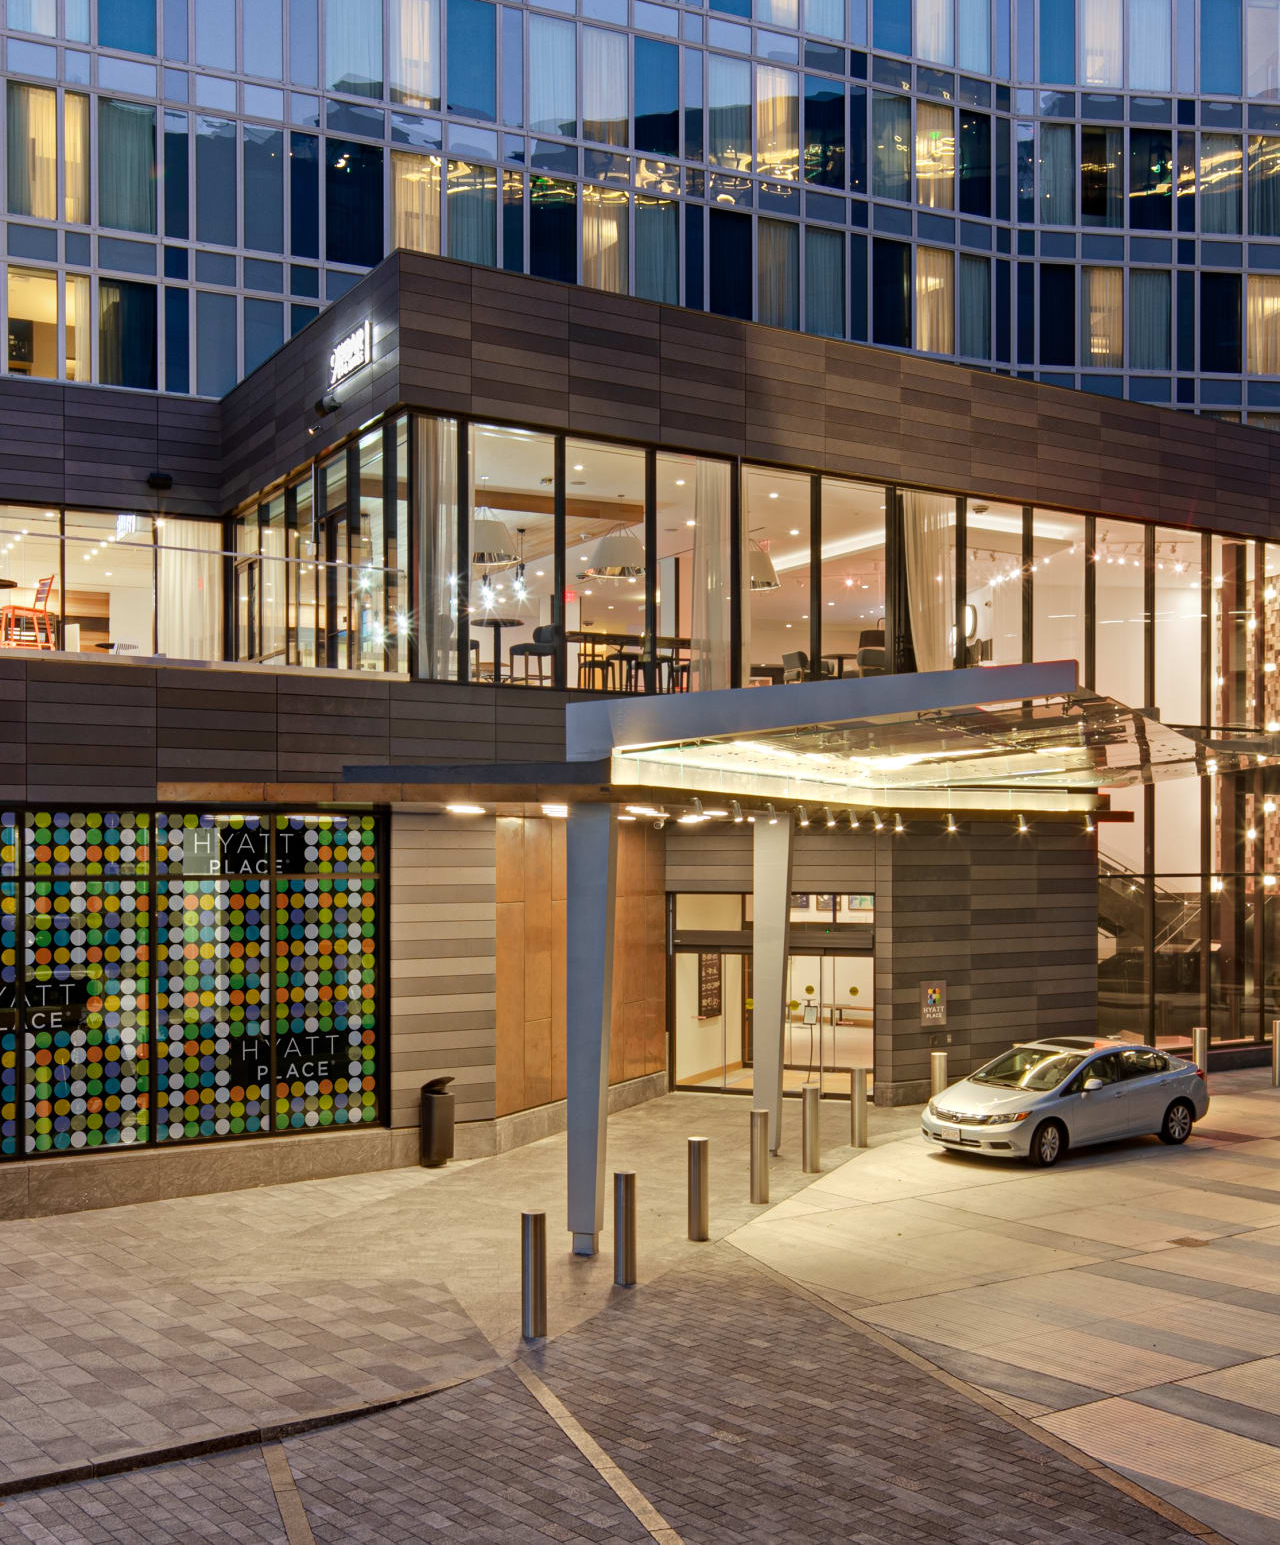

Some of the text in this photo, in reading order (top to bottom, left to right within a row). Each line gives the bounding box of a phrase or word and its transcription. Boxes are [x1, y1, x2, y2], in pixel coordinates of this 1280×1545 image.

[194, 833, 294, 854] HYATT
[923, 1006, 945, 1014] HYATT
[257, 1061, 329, 1081] PACE
